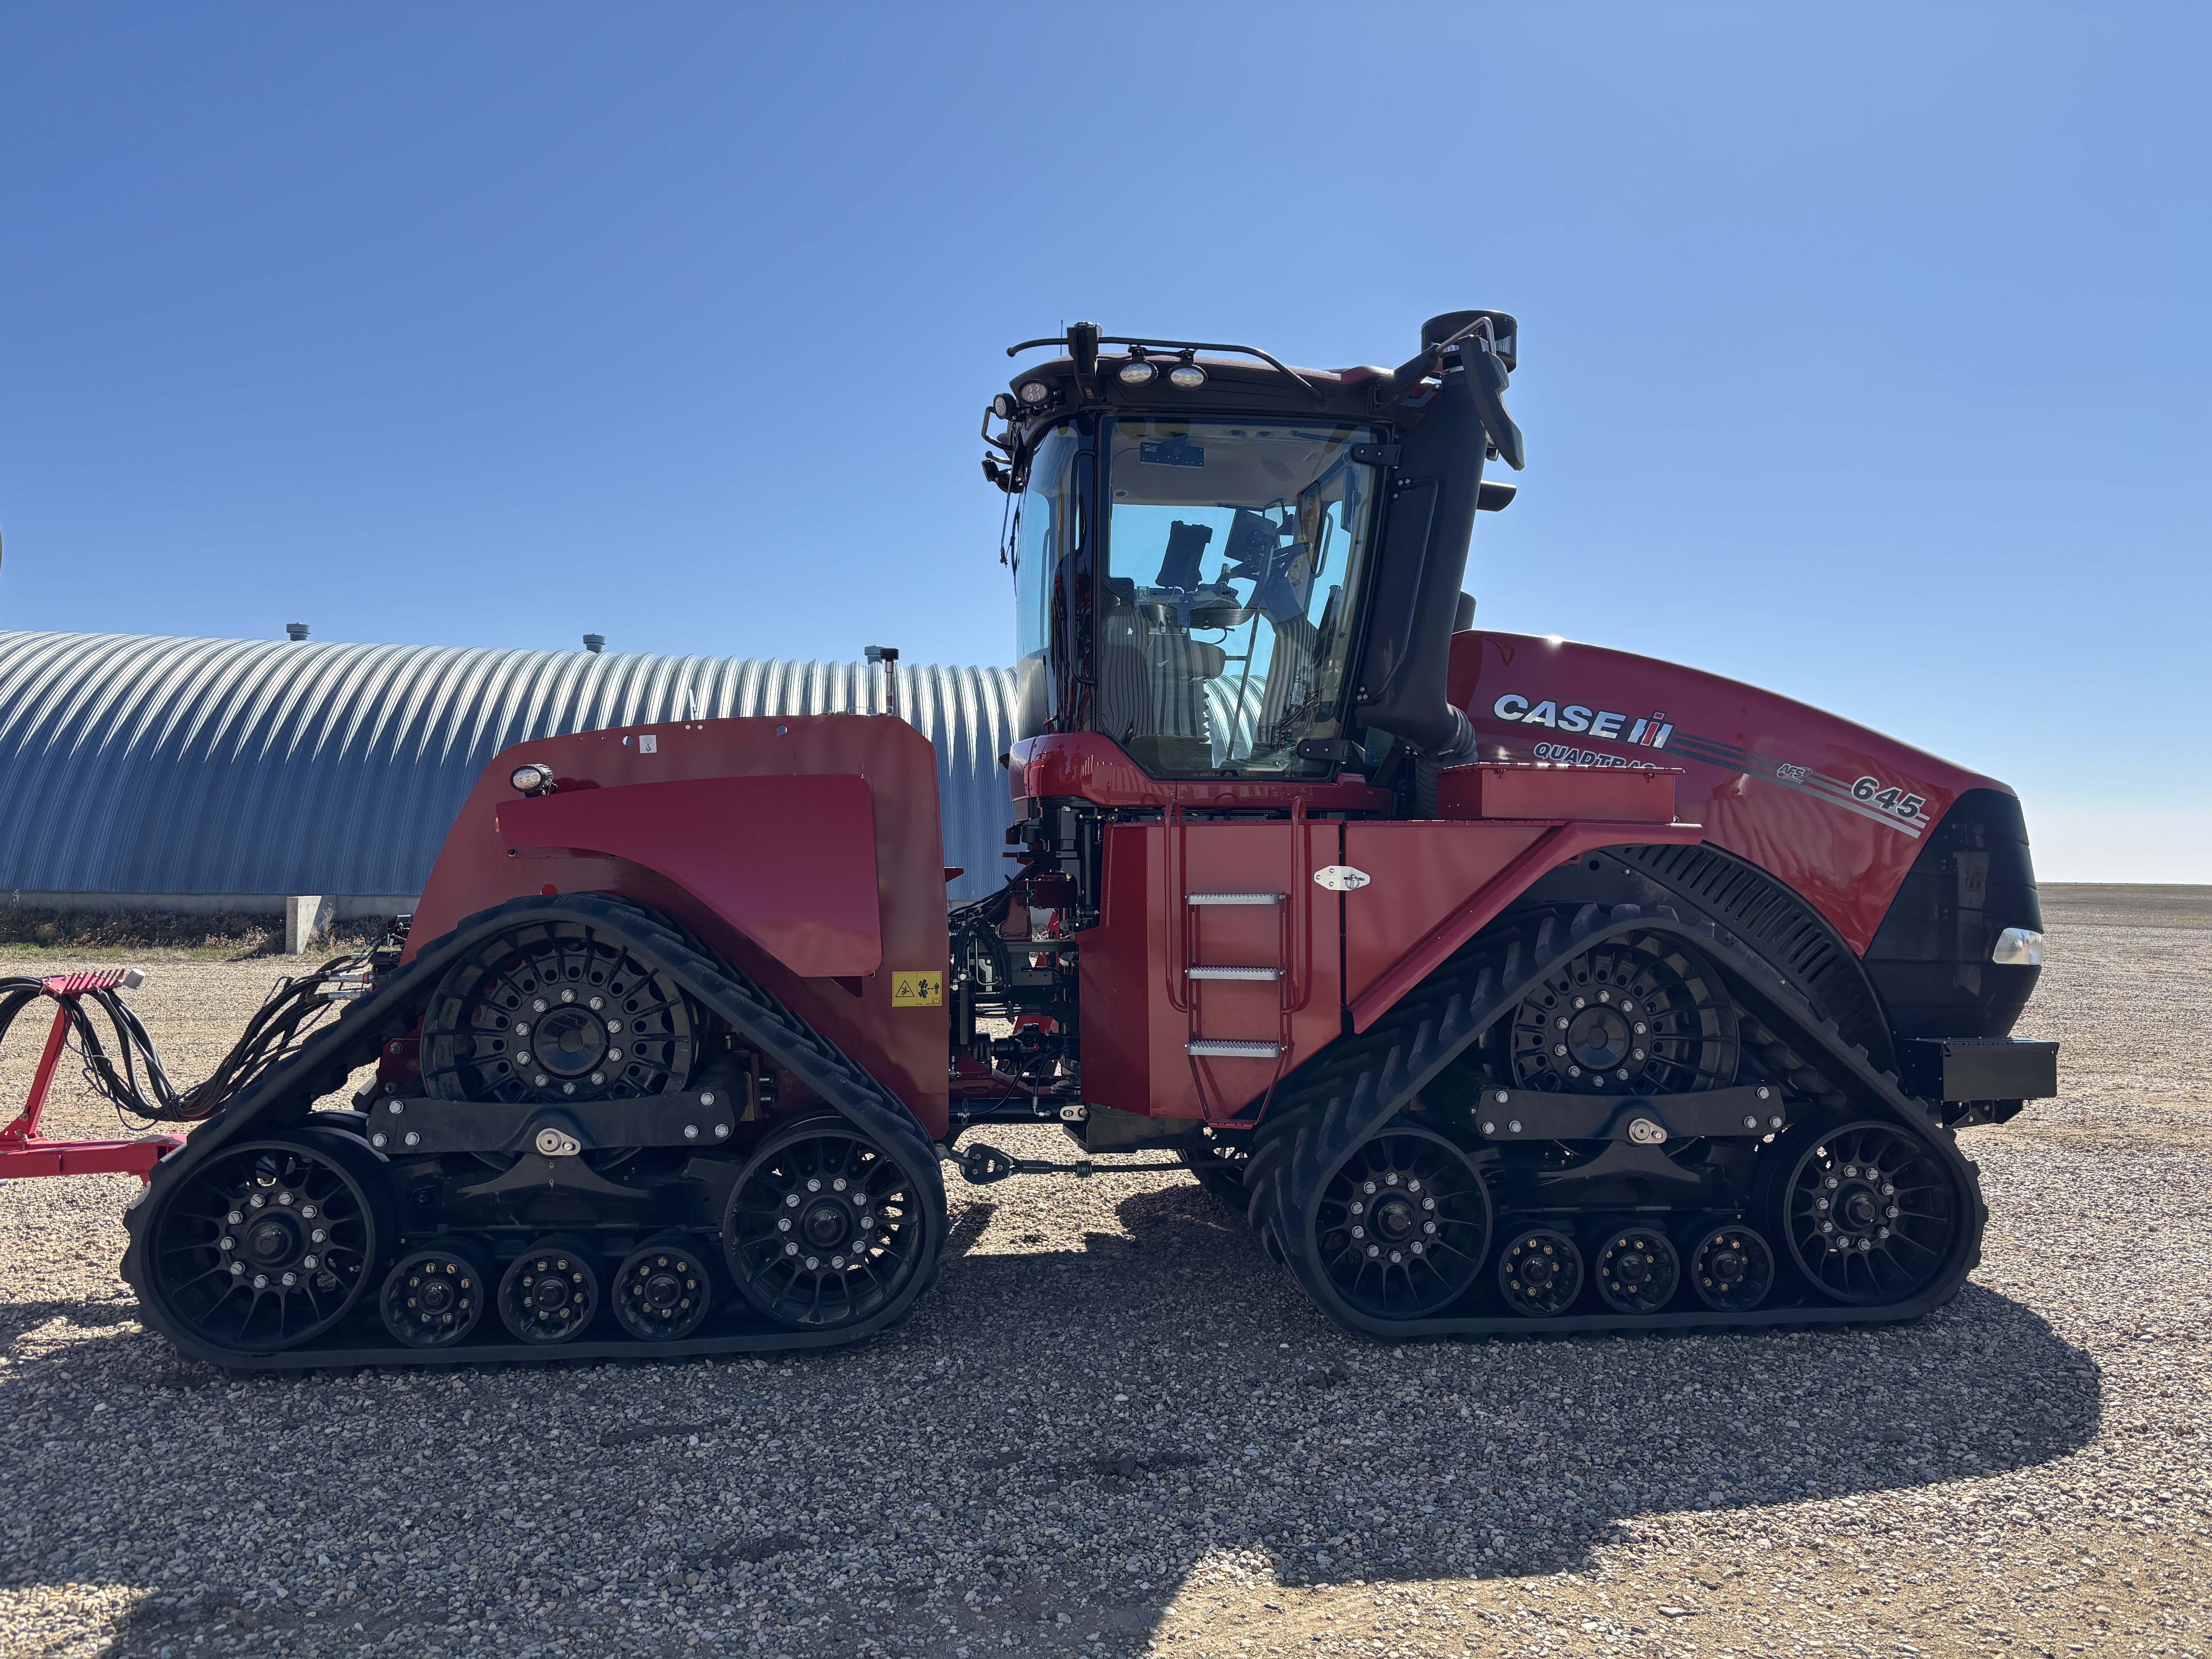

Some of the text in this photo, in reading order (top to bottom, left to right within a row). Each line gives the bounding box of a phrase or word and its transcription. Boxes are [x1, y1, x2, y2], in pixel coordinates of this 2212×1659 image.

[1494, 694, 1627, 739] CASE
[1534, 742, 1656, 768] QUADTR
[1777, 763, 1806, 777] AFS
[1851, 776, 1927, 820] 645
